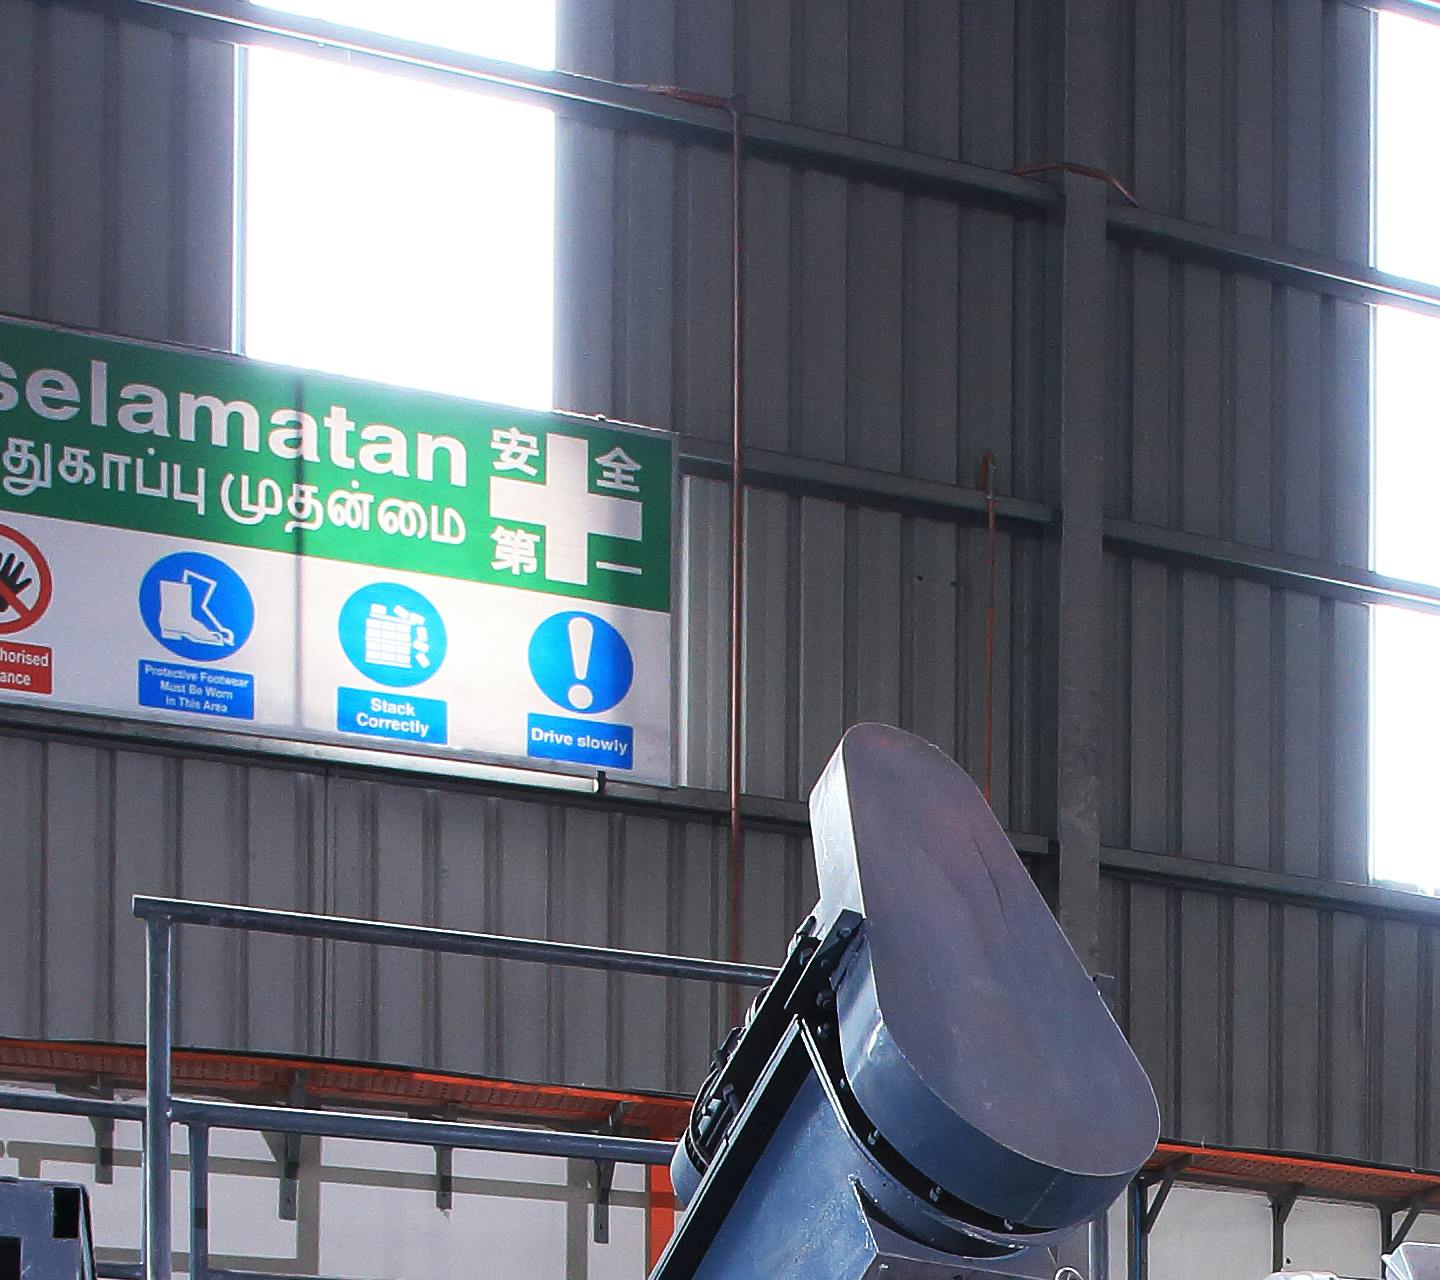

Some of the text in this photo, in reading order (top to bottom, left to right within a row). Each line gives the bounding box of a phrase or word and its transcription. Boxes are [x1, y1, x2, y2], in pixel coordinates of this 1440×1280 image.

[144, 664, 249, 688] Protective Footwear
[160, 680, 233, 700] Must Be Worn
[179, 697, 200, 710] This
[203, 700, 228, 712] Area
[370, 697, 416, 717] Stack
[355, 711, 430, 738] Correctly
[531, 727, 628, 756] Drive slowly
